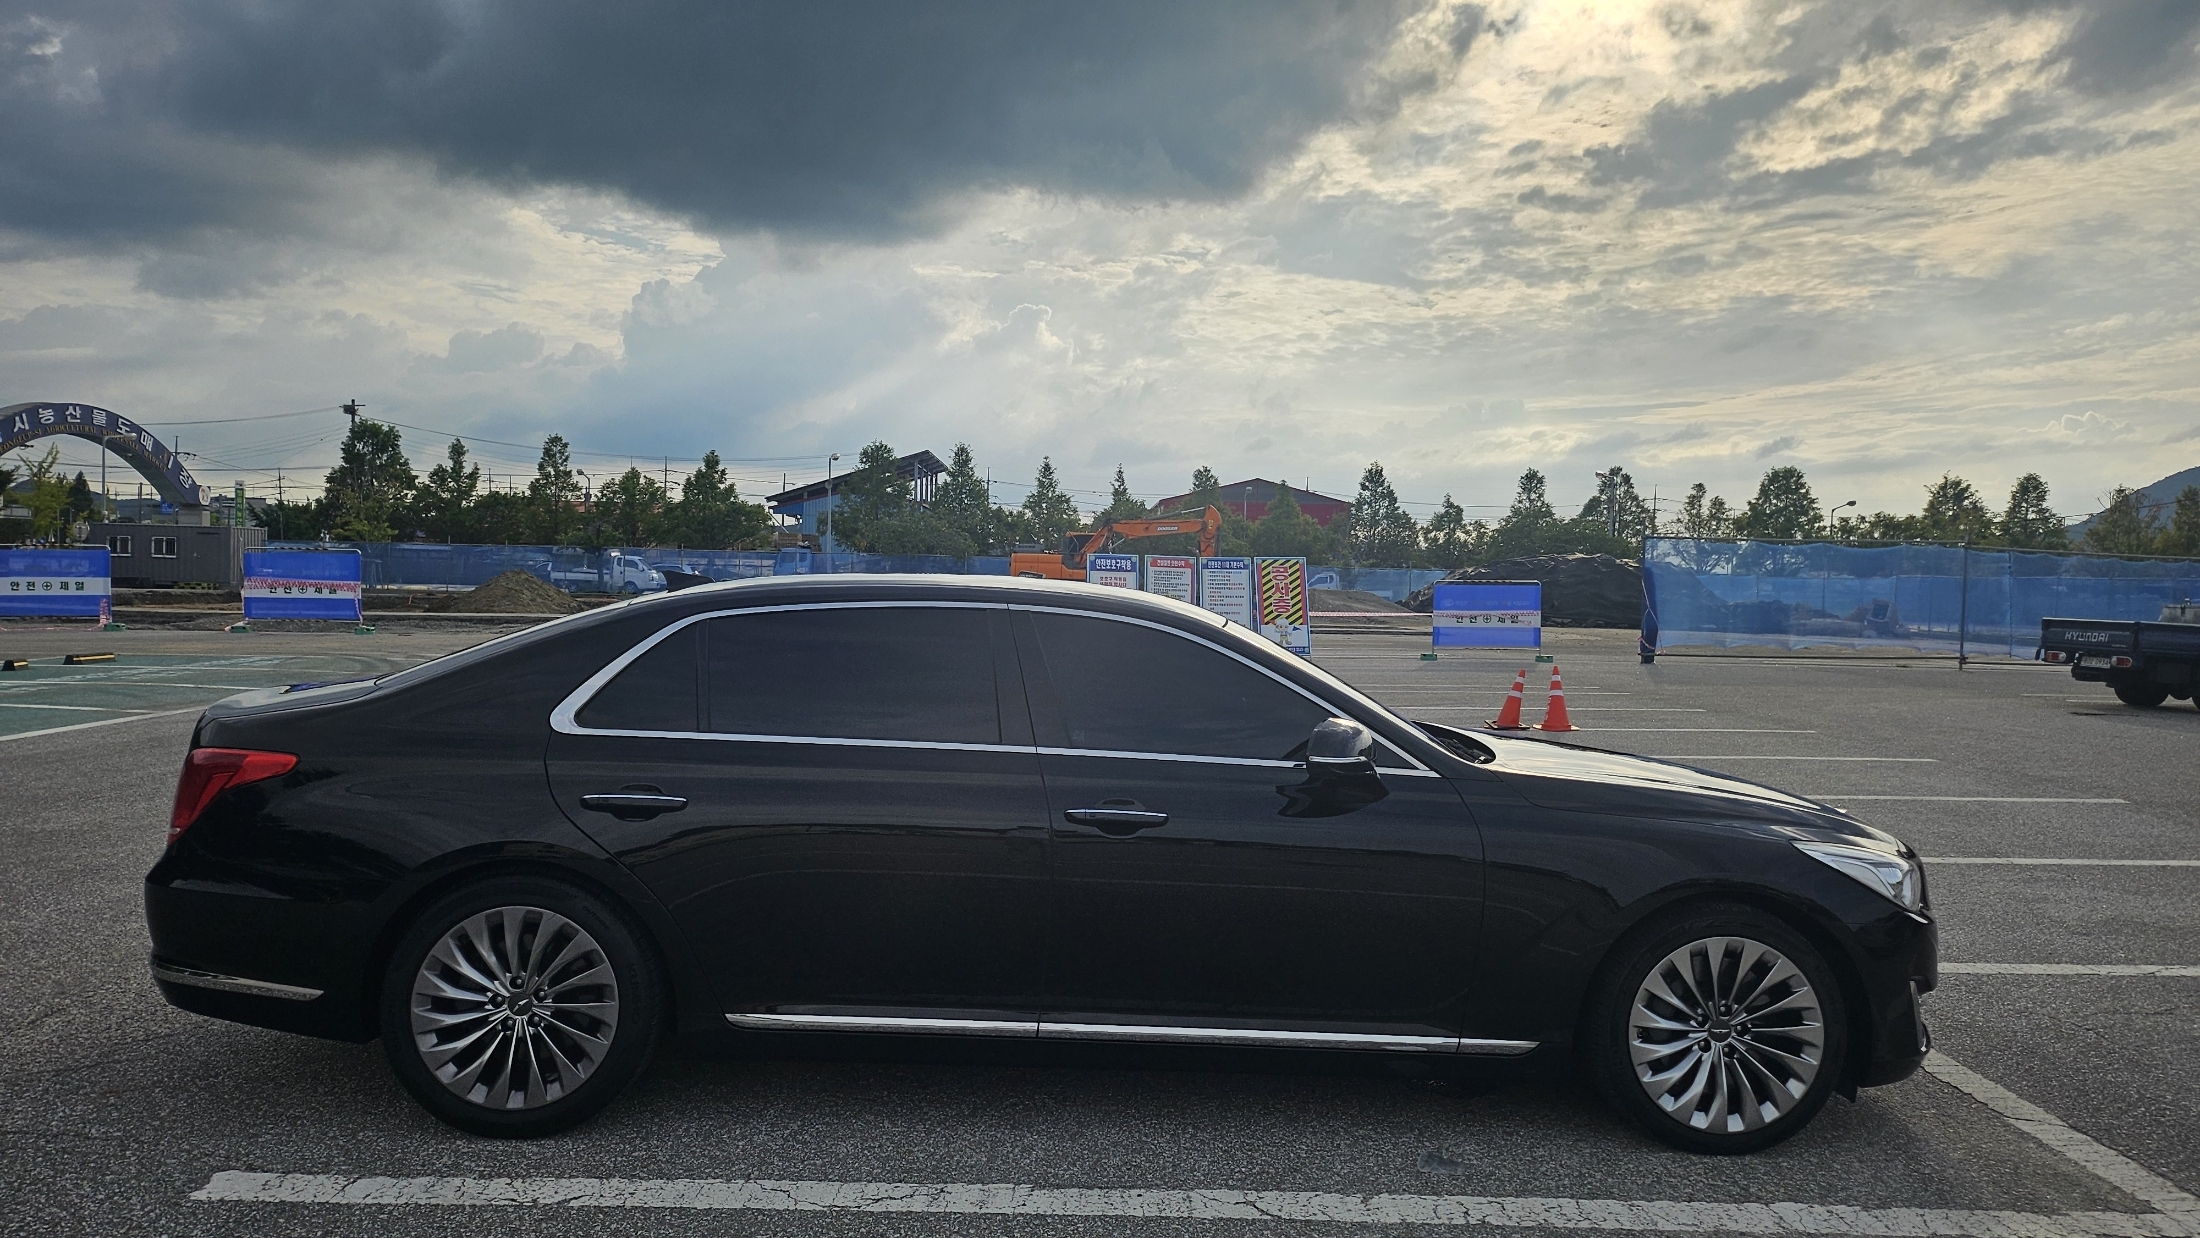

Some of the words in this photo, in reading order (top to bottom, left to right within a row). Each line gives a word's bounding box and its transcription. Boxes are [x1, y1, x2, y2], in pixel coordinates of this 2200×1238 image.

[0, 405, 192, 489] 시농산물도매시장
[10, 581, 36, 591] 안전
[59, 581, 85, 591] 제일
[1271, 565, 1291, 614] 공사중
[2064, 631, 2110, 643] HYUNDAI
